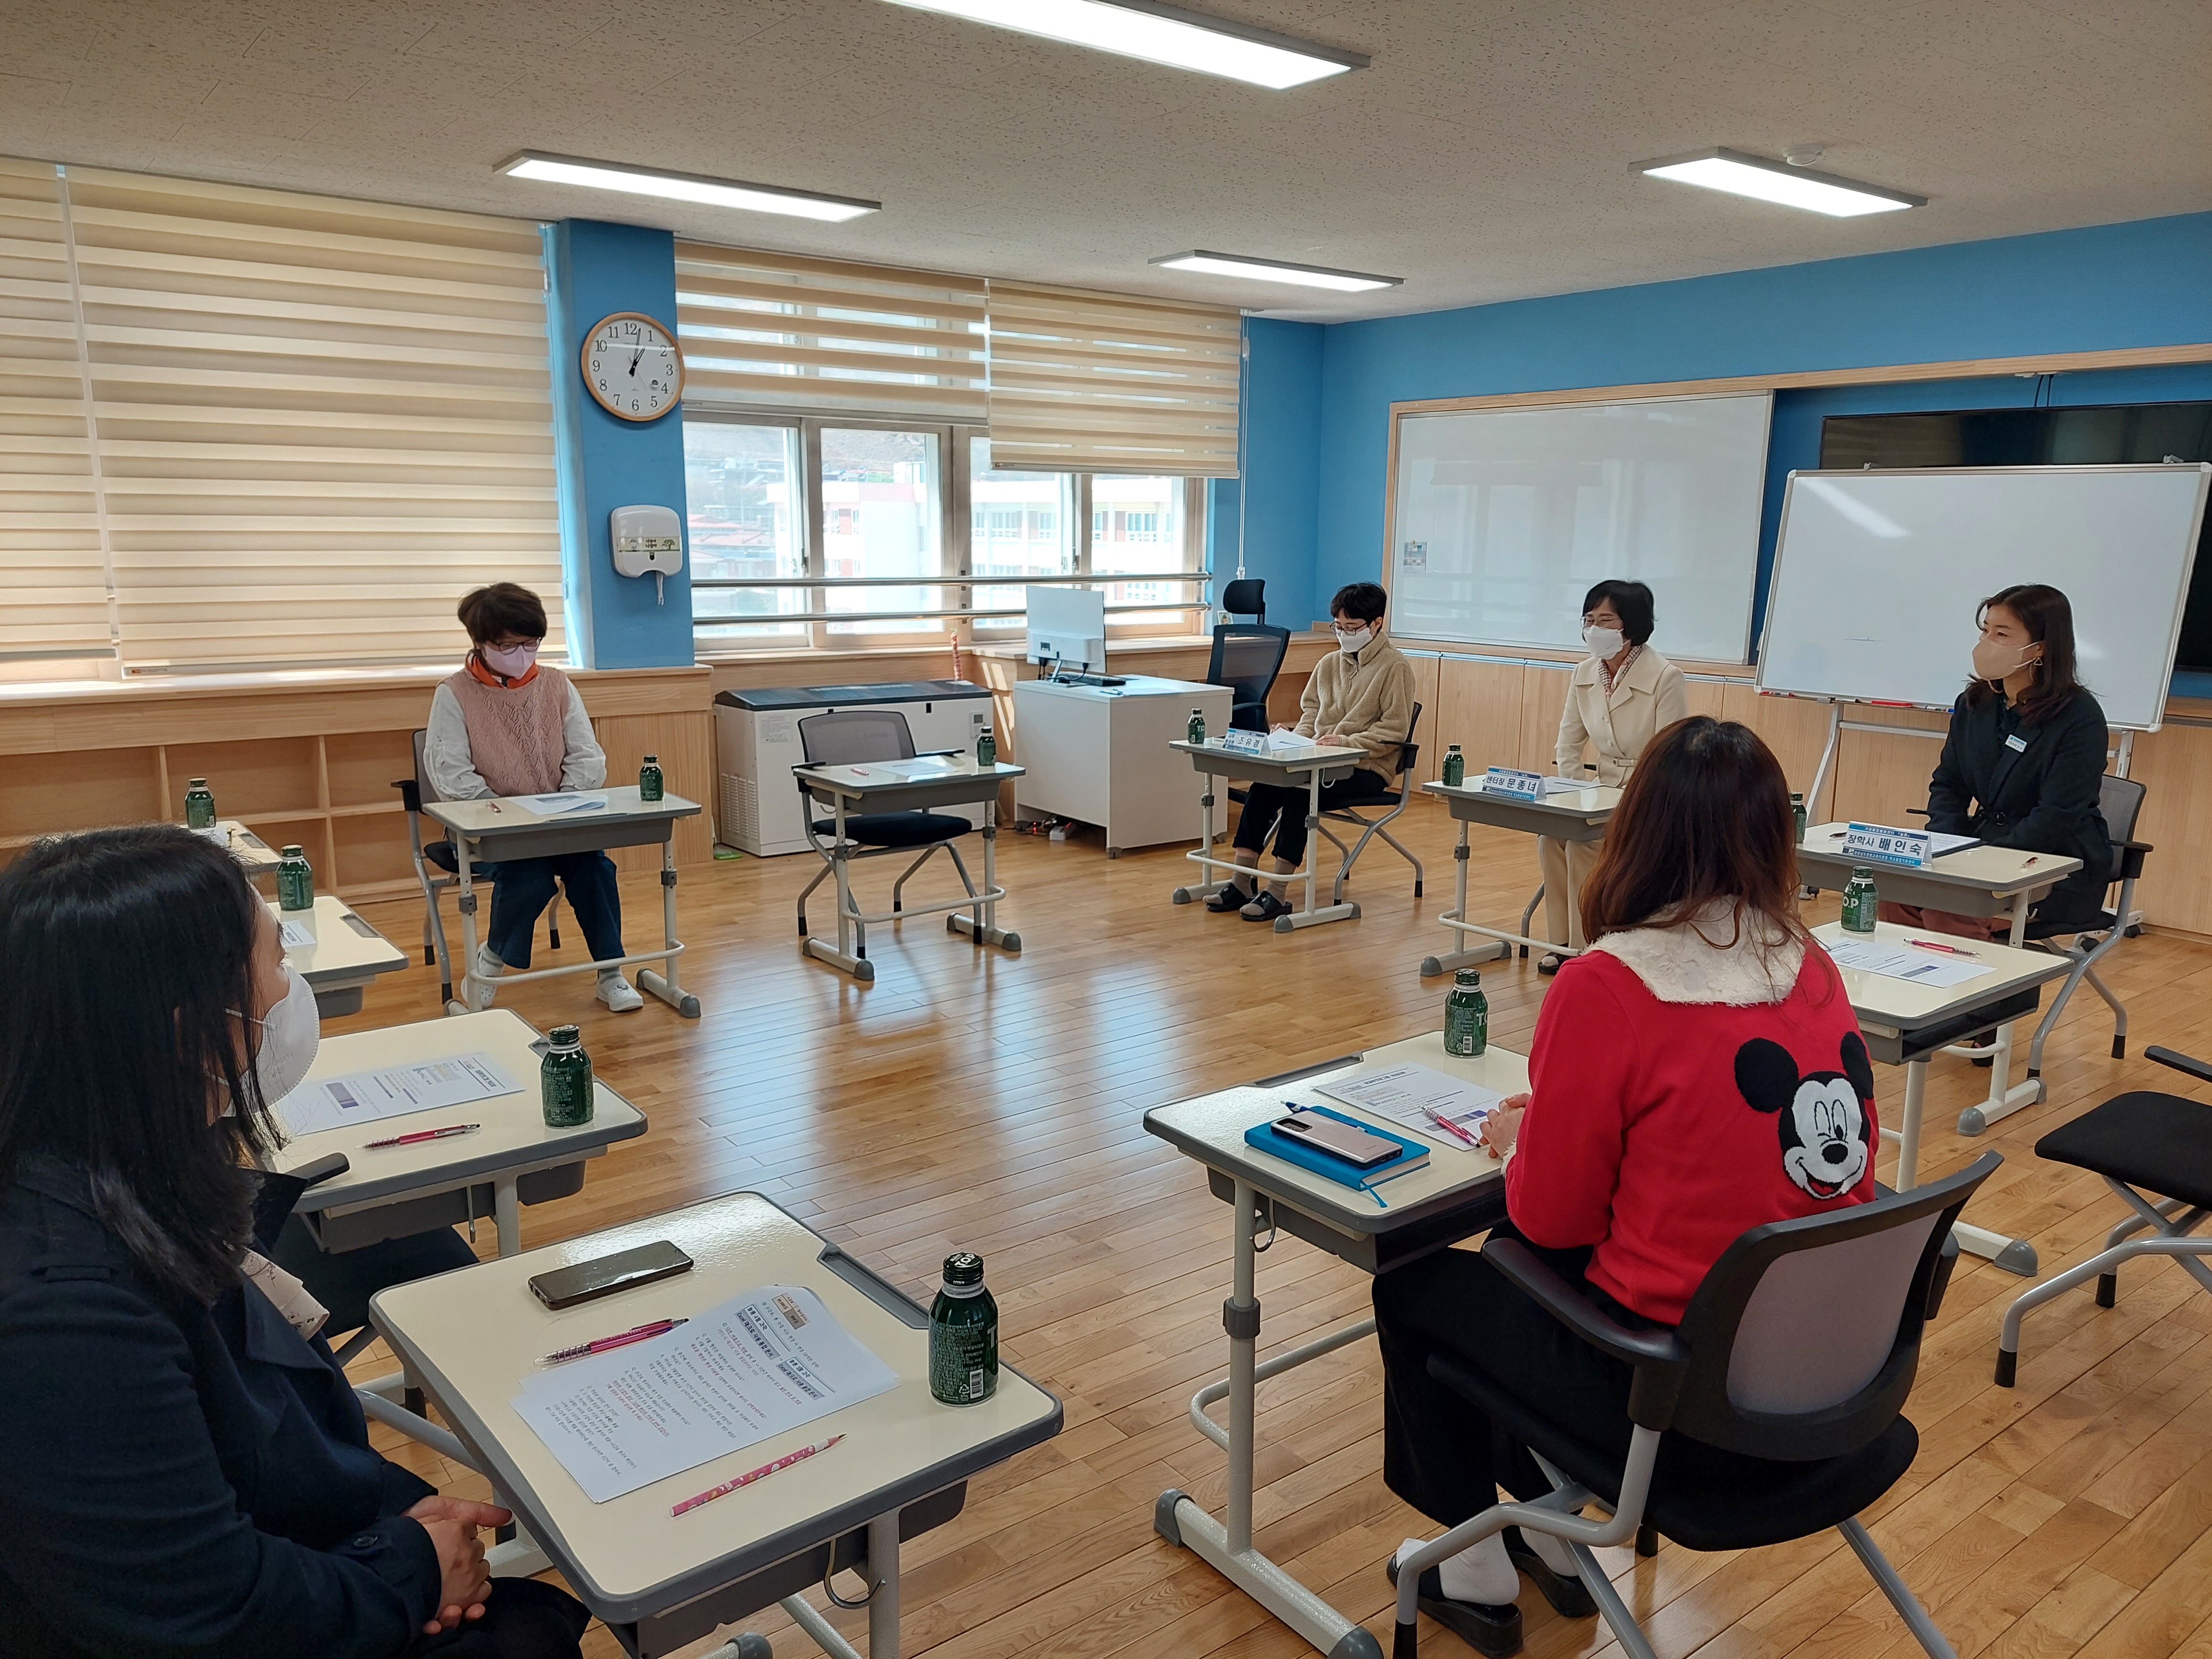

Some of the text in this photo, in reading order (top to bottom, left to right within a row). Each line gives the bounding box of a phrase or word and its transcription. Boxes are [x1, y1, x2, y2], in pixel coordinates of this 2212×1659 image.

[608, 325, 620, 339] 11
[623, 322, 638, 336] 12
[648, 330, 654, 342] 1
[595, 340, 608, 353] 10
[660, 345, 668, 357] 2
[593, 360, 600, 372] 9
[665, 364, 674, 376] 3
[599, 378, 608, 391] 8
[661, 382, 669, 395] 4
[613, 394, 621, 406] 7
[631, 399, 640, 411] 6
[650, 396, 658, 408] 5
[1486, 775, 1504, 785] 센터장
[1848, 834, 1875, 847] 장학사
[736, 1311, 746, 1322] Excel
[744, 1321, 755, 1334] 매크로
[777, 1363, 789, 1372] Excel
